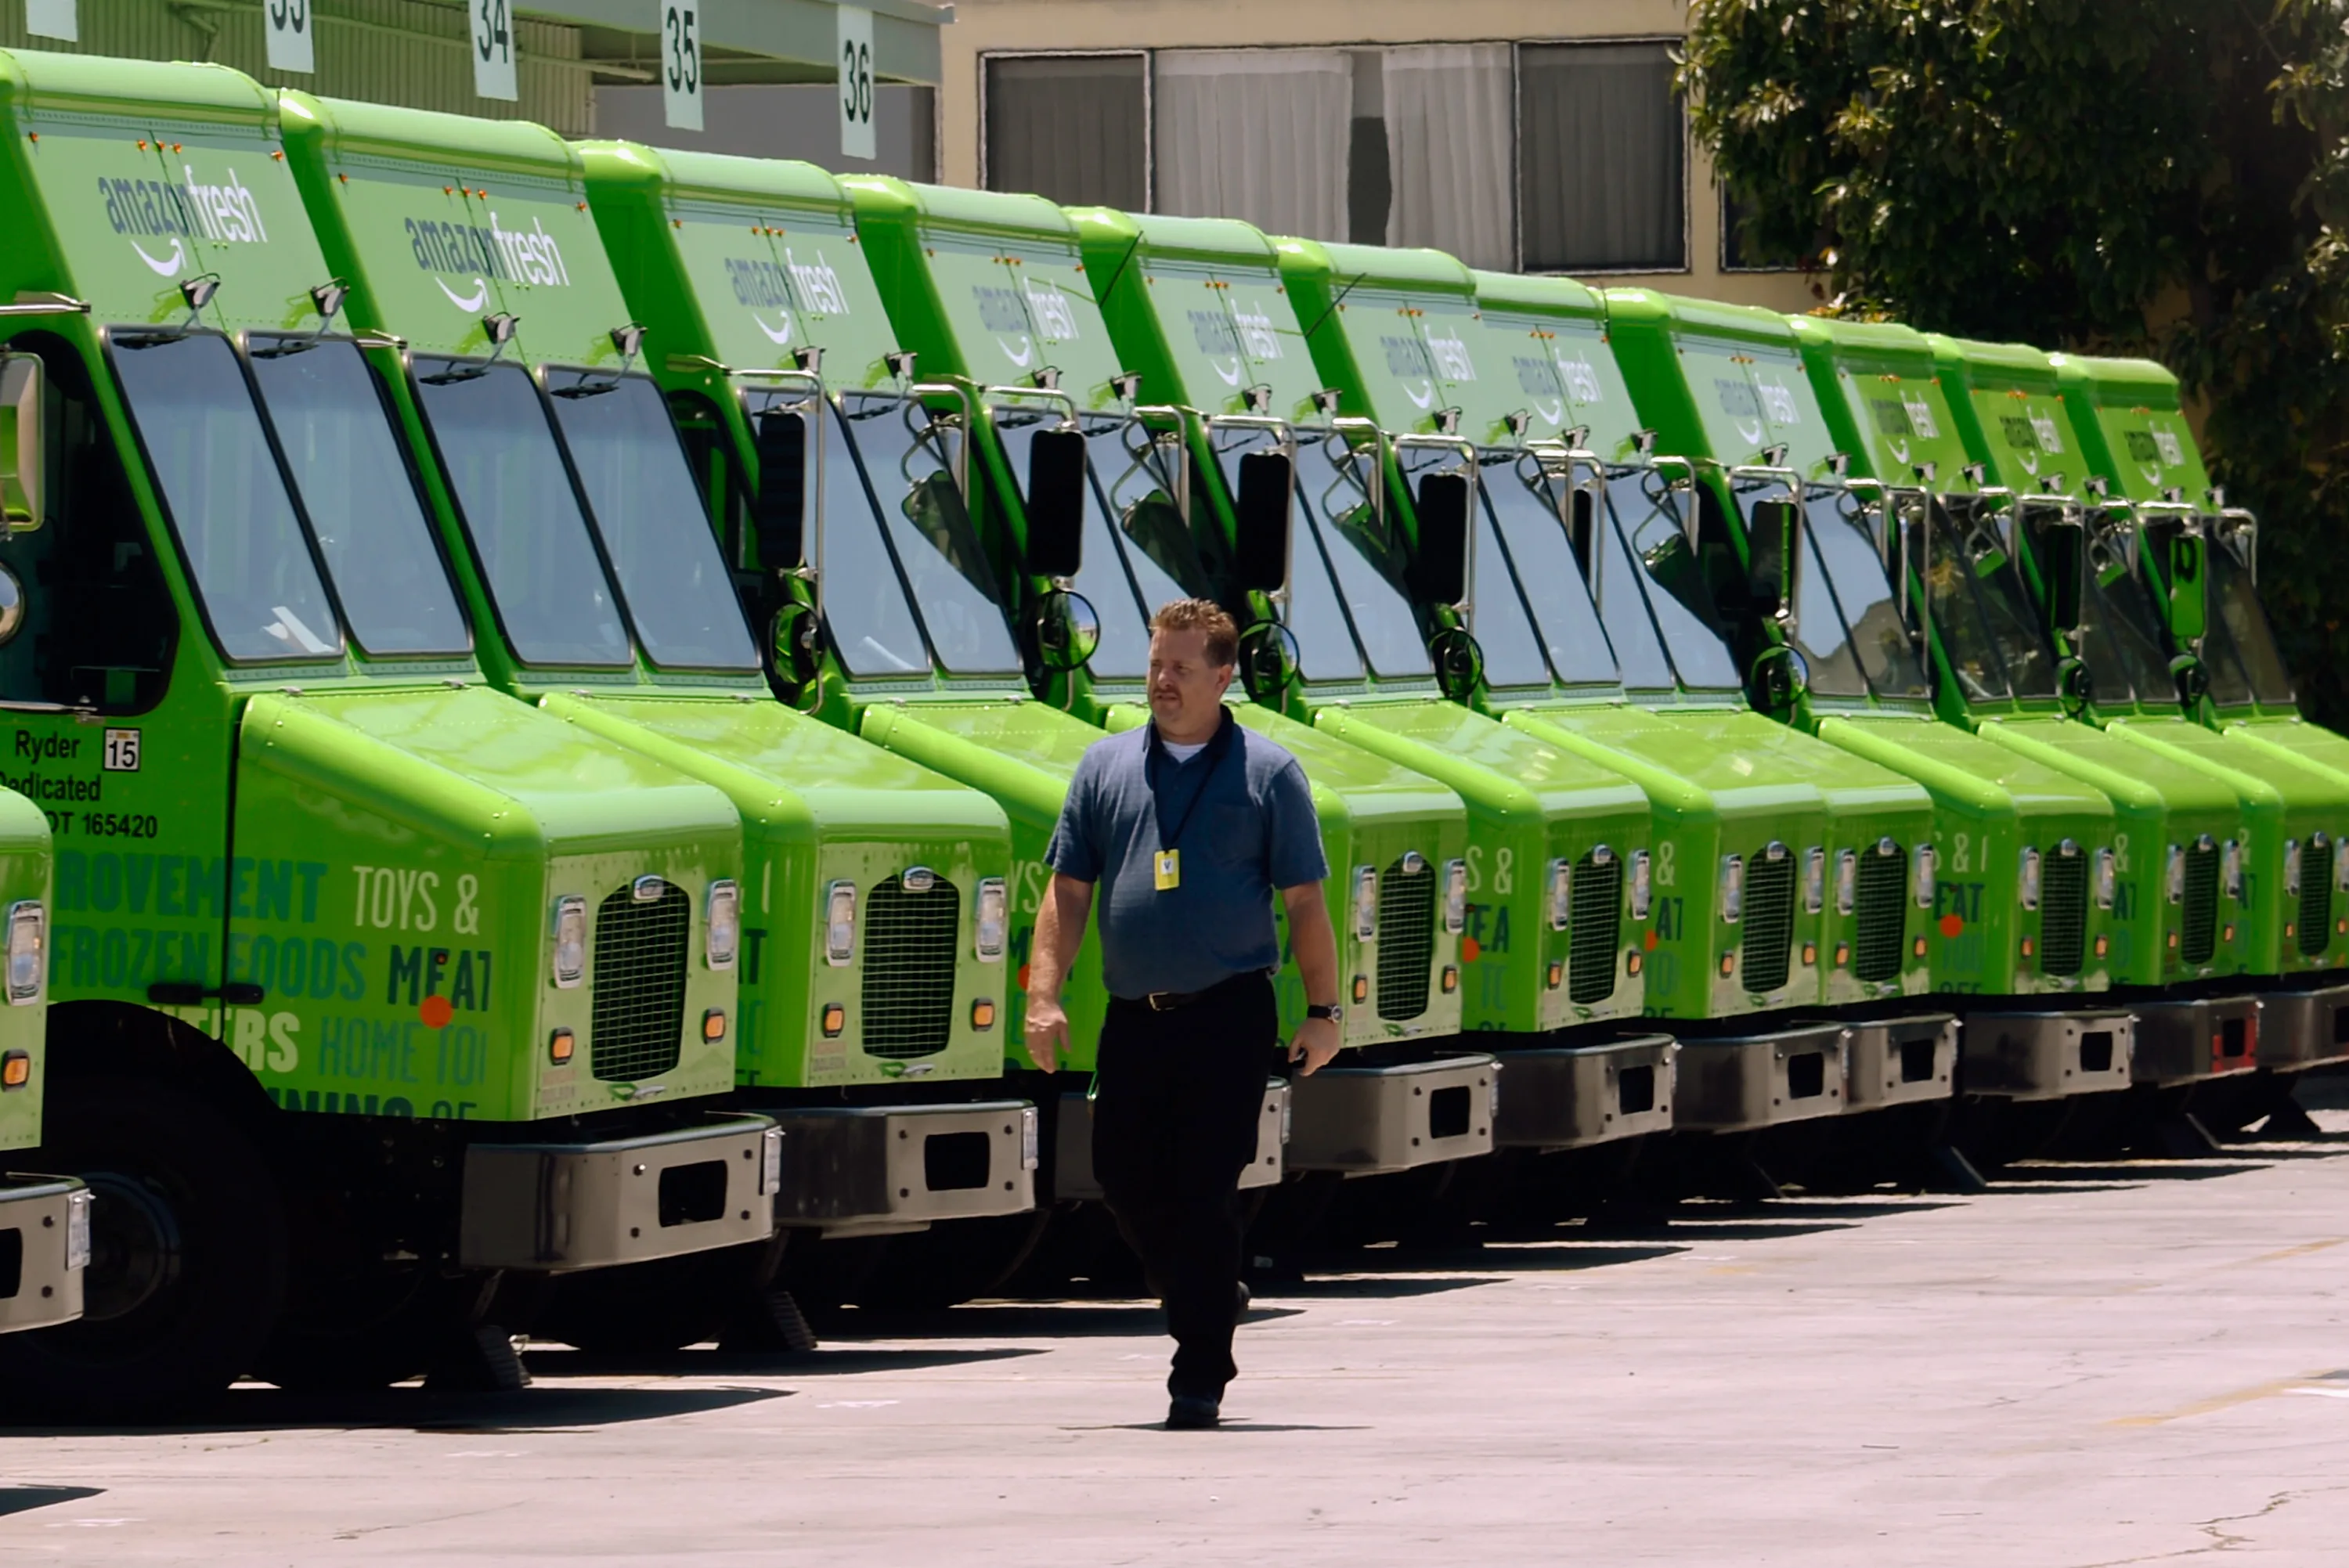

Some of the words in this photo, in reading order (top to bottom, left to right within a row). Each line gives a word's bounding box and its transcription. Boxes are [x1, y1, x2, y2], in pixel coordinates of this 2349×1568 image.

[667, 6, 696, 95] 35
[844, 39, 871, 124] 36
[16, 730, 81, 764] Ryder
[109, 740, 135, 767] 15
[0, 771, 102, 802] edicated
[82, 812, 157, 838] 165420
[353, 866, 440, 932] TOYS
[453, 874, 480, 935] &
[49, 924, 210, 989] FROZEN
[229, 932, 367, 1002] FOODS
